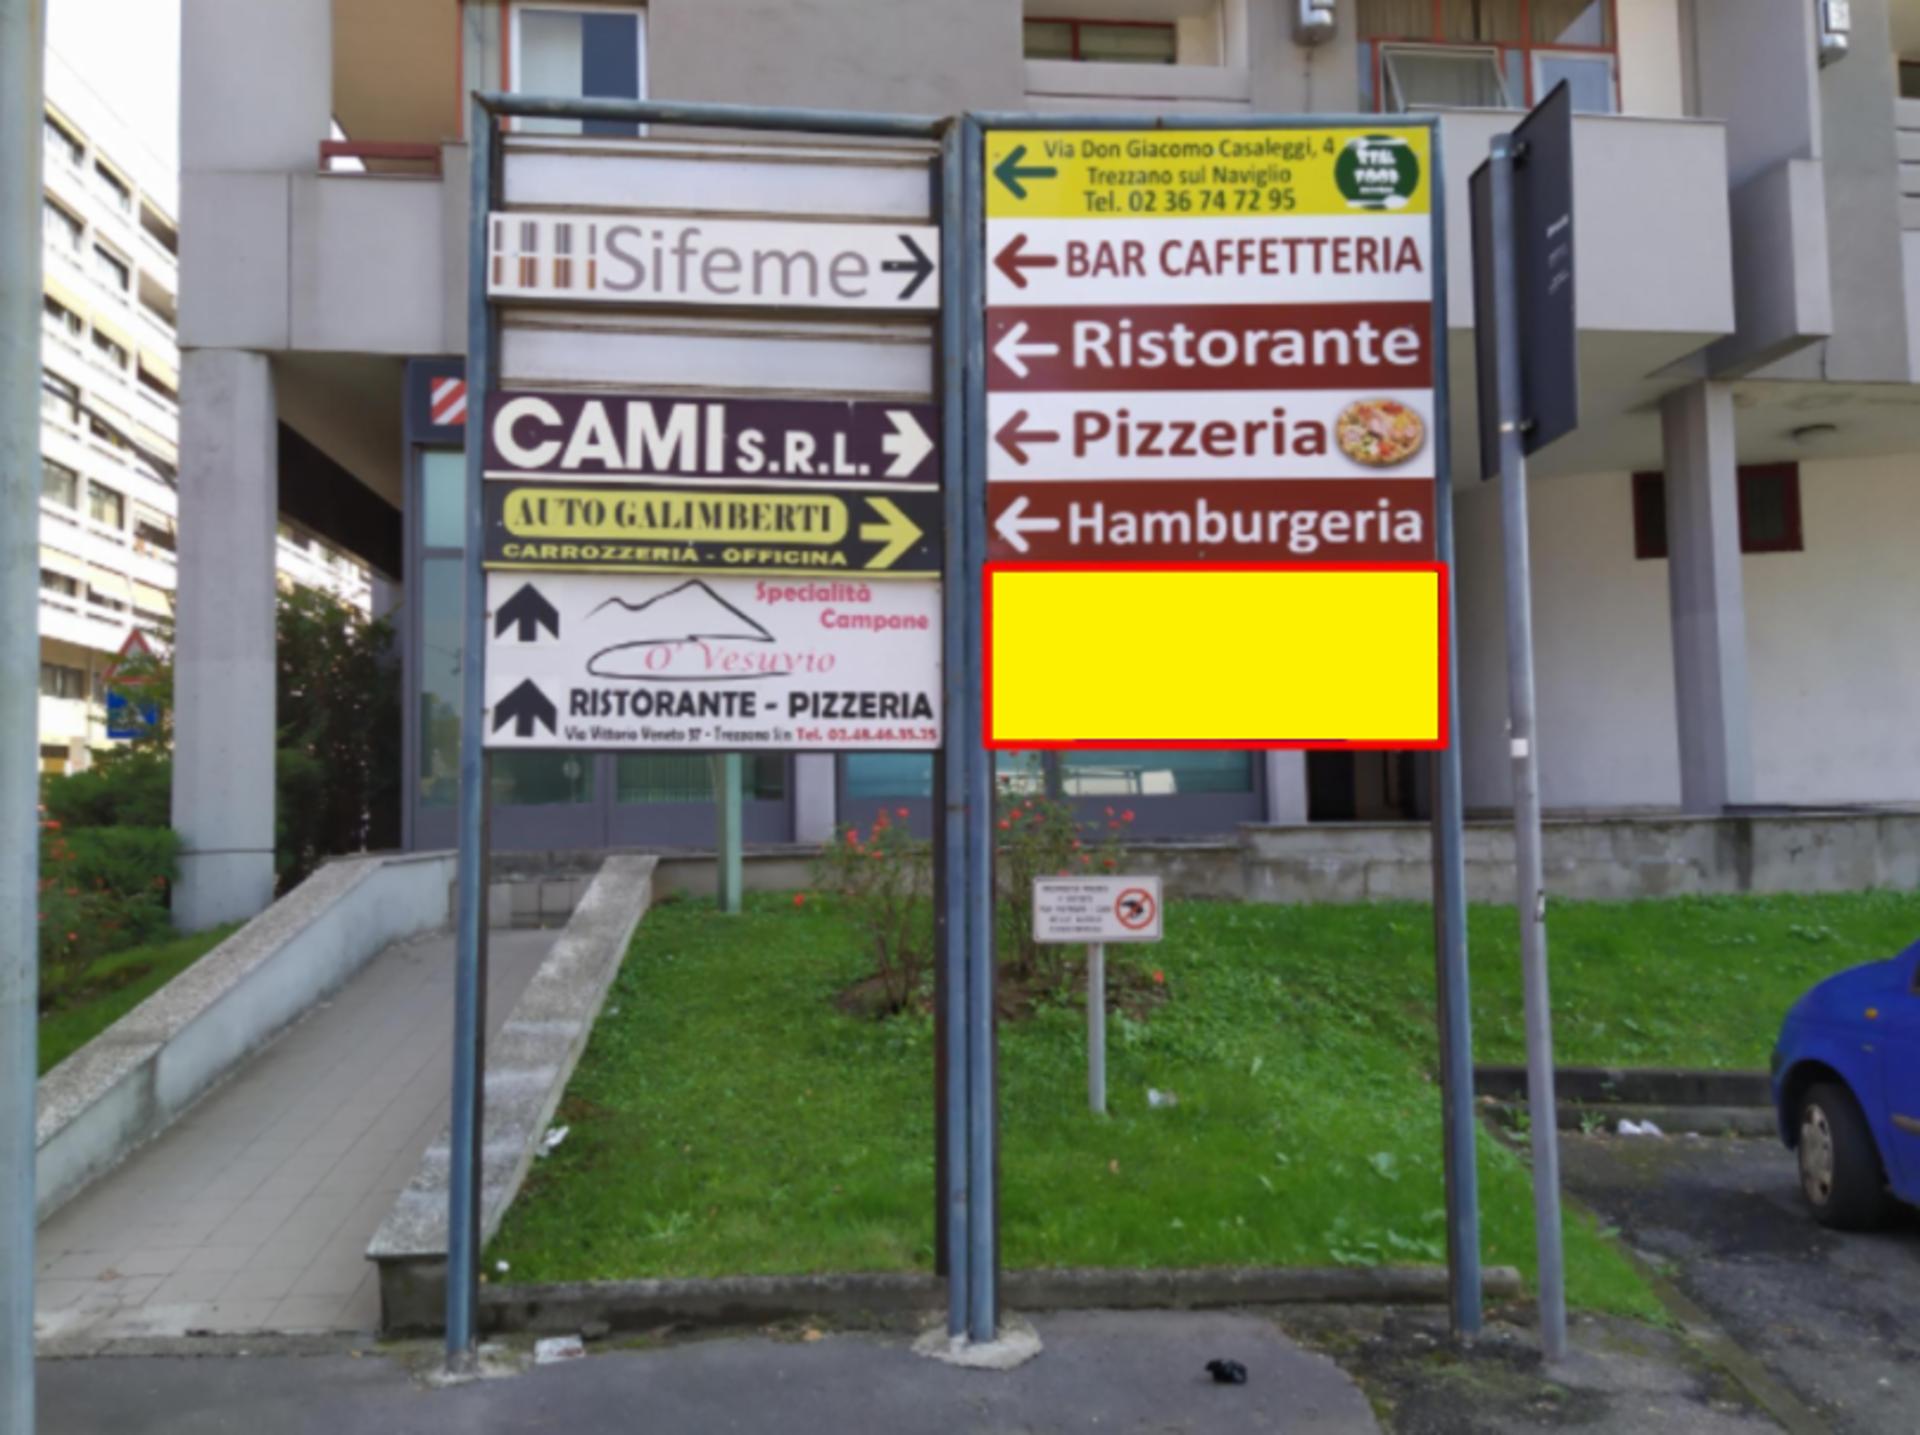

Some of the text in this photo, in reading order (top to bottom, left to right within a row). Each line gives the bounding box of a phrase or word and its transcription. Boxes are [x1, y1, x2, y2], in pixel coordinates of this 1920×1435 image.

[1043, 137, 1335, 161] Via Don Giacomo Casaleggi, 4
[1087, 164, 1292, 188] Trezzano sul Naviglio
[1083, 187, 1296, 211] Tel. 02 36 74 72 95
[602, 224, 870, 299] Sifeme
[1065, 235, 1424, 279] BAR CAFFETTERIA
[1072, 318, 1421, 369] Ristorante
[492, 396, 871, 476] CAMI S.R.L.
[1073, 406, 1328, 458] Pizzeria
[514, 496, 832, 533] AUTO GALIMBERTI
[1068, 497, 1424, 554] Hamburgeria
[502, 542, 700, 562] CARROZZERIA
[721, 547, 848, 566] OFFICINA
[755, 580, 872, 604] Specialità
[819, 608, 930, 632] Campane
[697, 642, 837, 674] Vesuvio
[569, 688, 757, 718] RISTORANTE
[788, 692, 934, 720] PIZZERIA
[564, 725, 587, 741] Via
[590, 725, 638, 742] Vittorio
[640, 726, 686, 742] Veneto
[795, 726, 823, 742] Tel.
